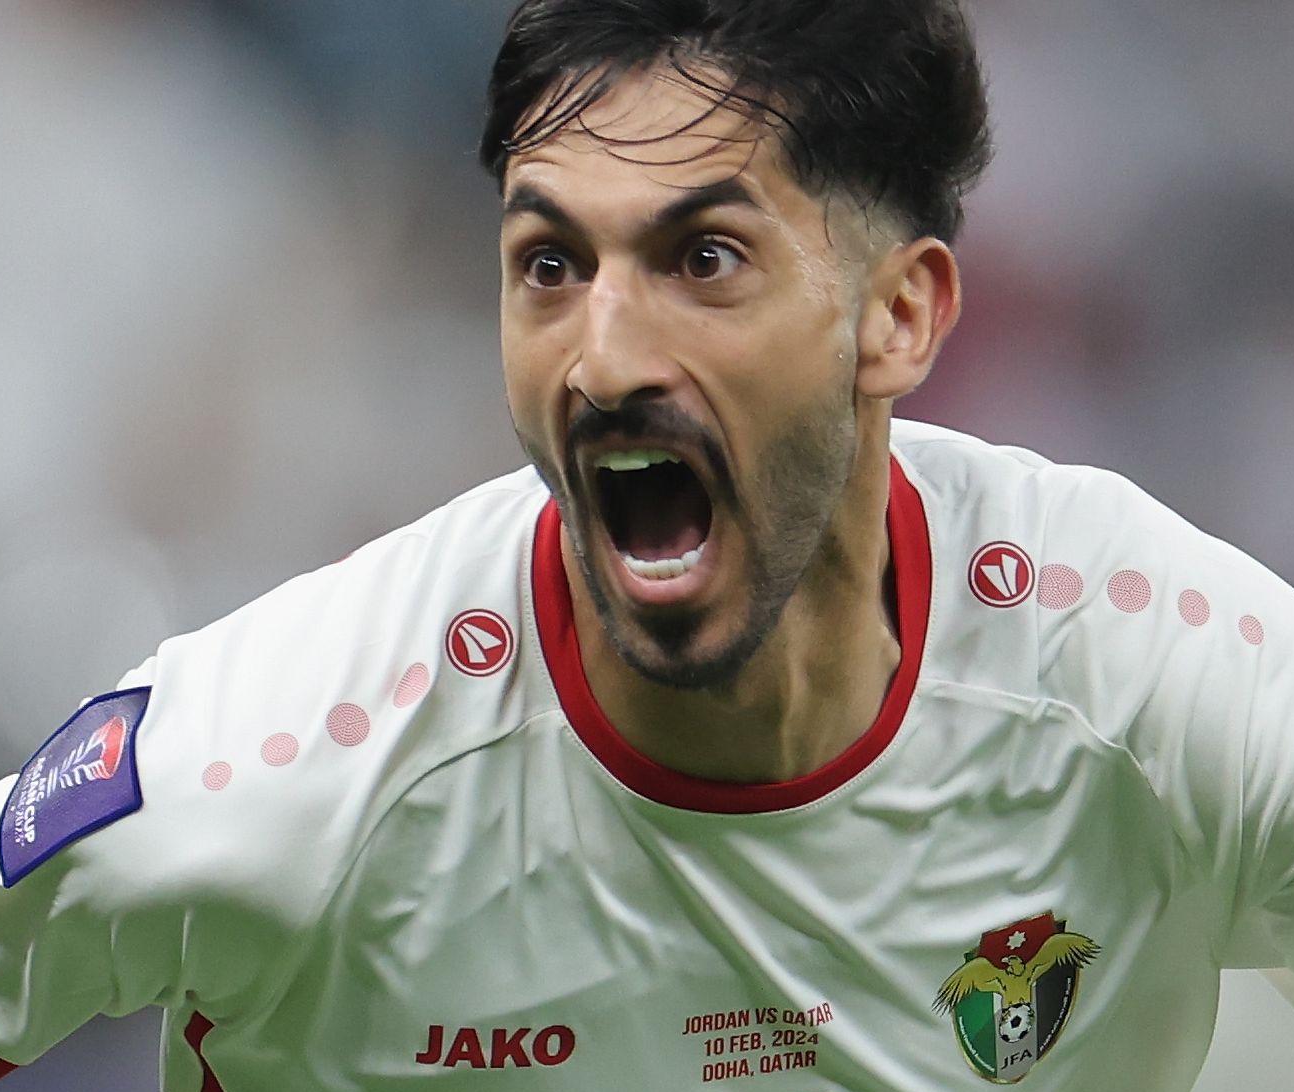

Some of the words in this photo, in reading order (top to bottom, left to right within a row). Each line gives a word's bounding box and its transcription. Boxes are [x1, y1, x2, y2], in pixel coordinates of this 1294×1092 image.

[23, 805, 35, 843] CUP
[682, 1009, 750, 1035] JORDAN
[756, 1007, 778, 1025] VS
[782, 1002, 834, 1027] QATAR
[415, 1024, 576, 1069] JAKO
[704, 1037, 725, 1057] 10
[729, 1032, 767, 1053] FEB,
[771, 1029, 819, 1048] 2024
[1001, 1048, 1033, 1070] JFA
[702, 1058, 755, 1083] DOHA,
[760, 1050, 816, 1074] QATAR
